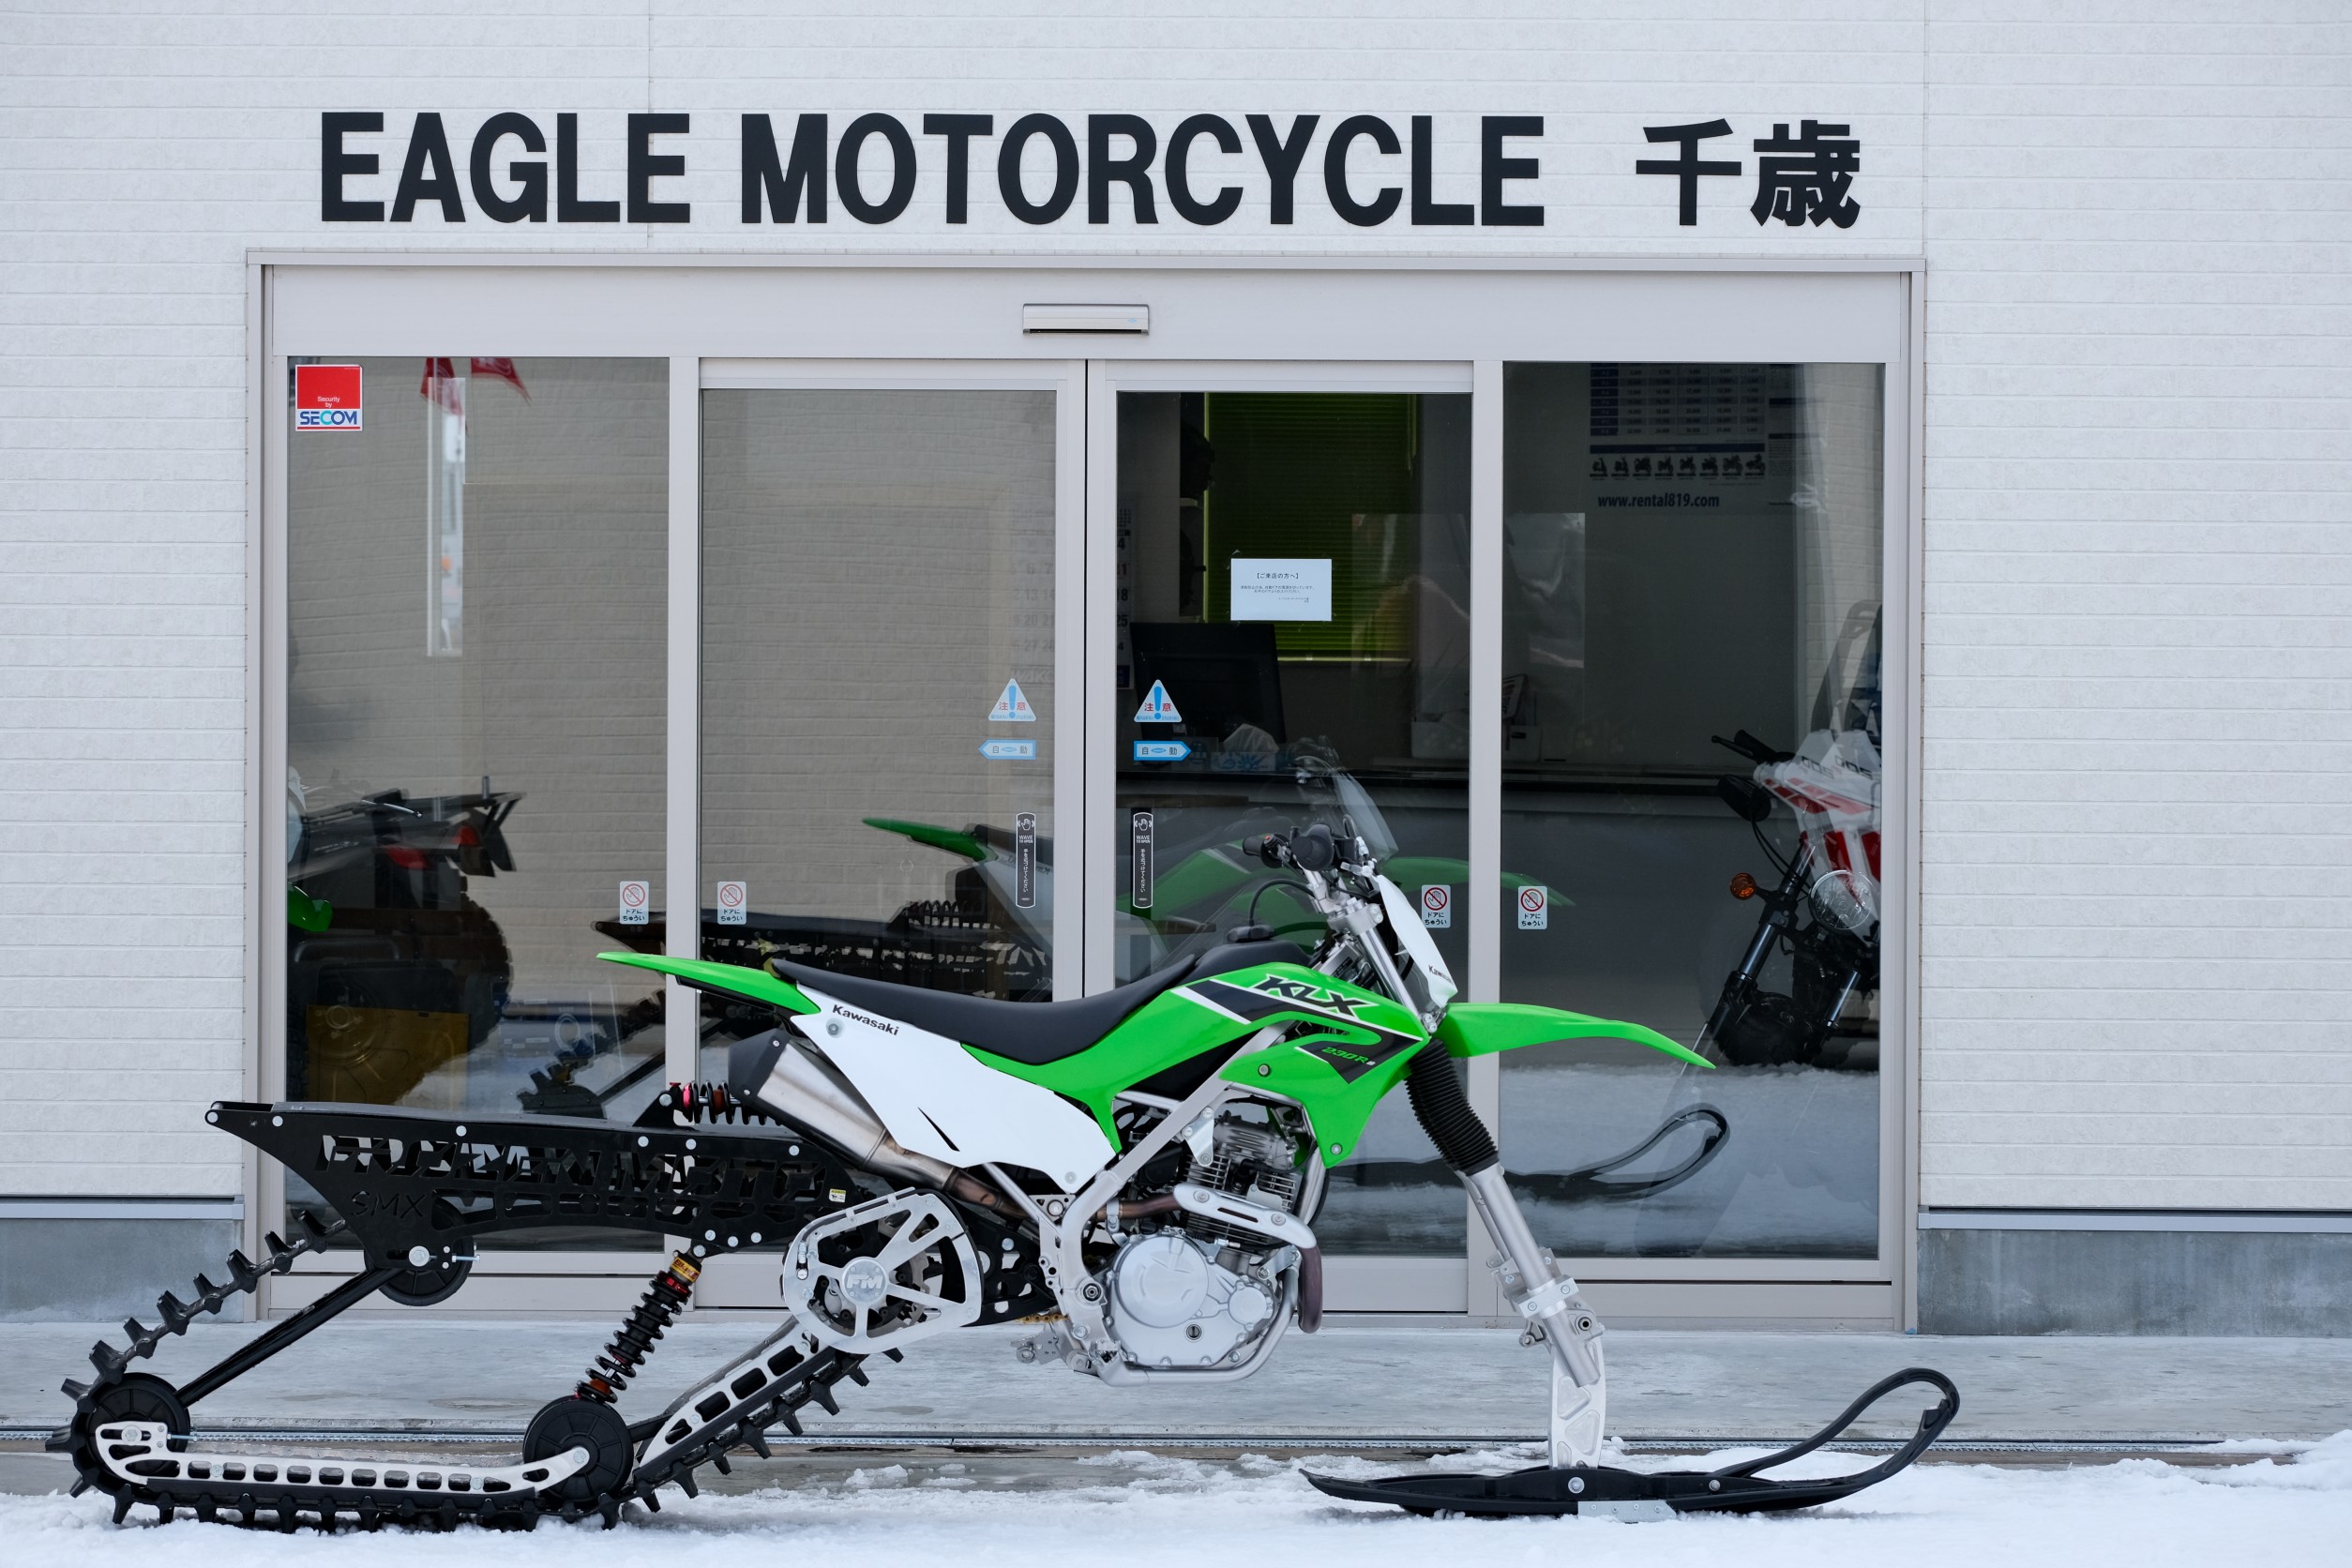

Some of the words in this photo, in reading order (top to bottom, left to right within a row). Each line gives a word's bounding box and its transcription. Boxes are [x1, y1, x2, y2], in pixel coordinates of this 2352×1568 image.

[322, 113, 690, 223] EAGLE
[742, 113, 1544, 227] MOTORCYCLE
[1636, 119, 1861, 229] 千歳
[300, 410, 357, 425] SECOM
[1598, 492, 1720, 507] www.rental819.com
[1253, 974, 1379, 1020] KLX
[833, 1004, 899, 1035] Kawasaki
[351, 1190, 426, 1218] SMX
[846, 1274, 883, 1289] FM
